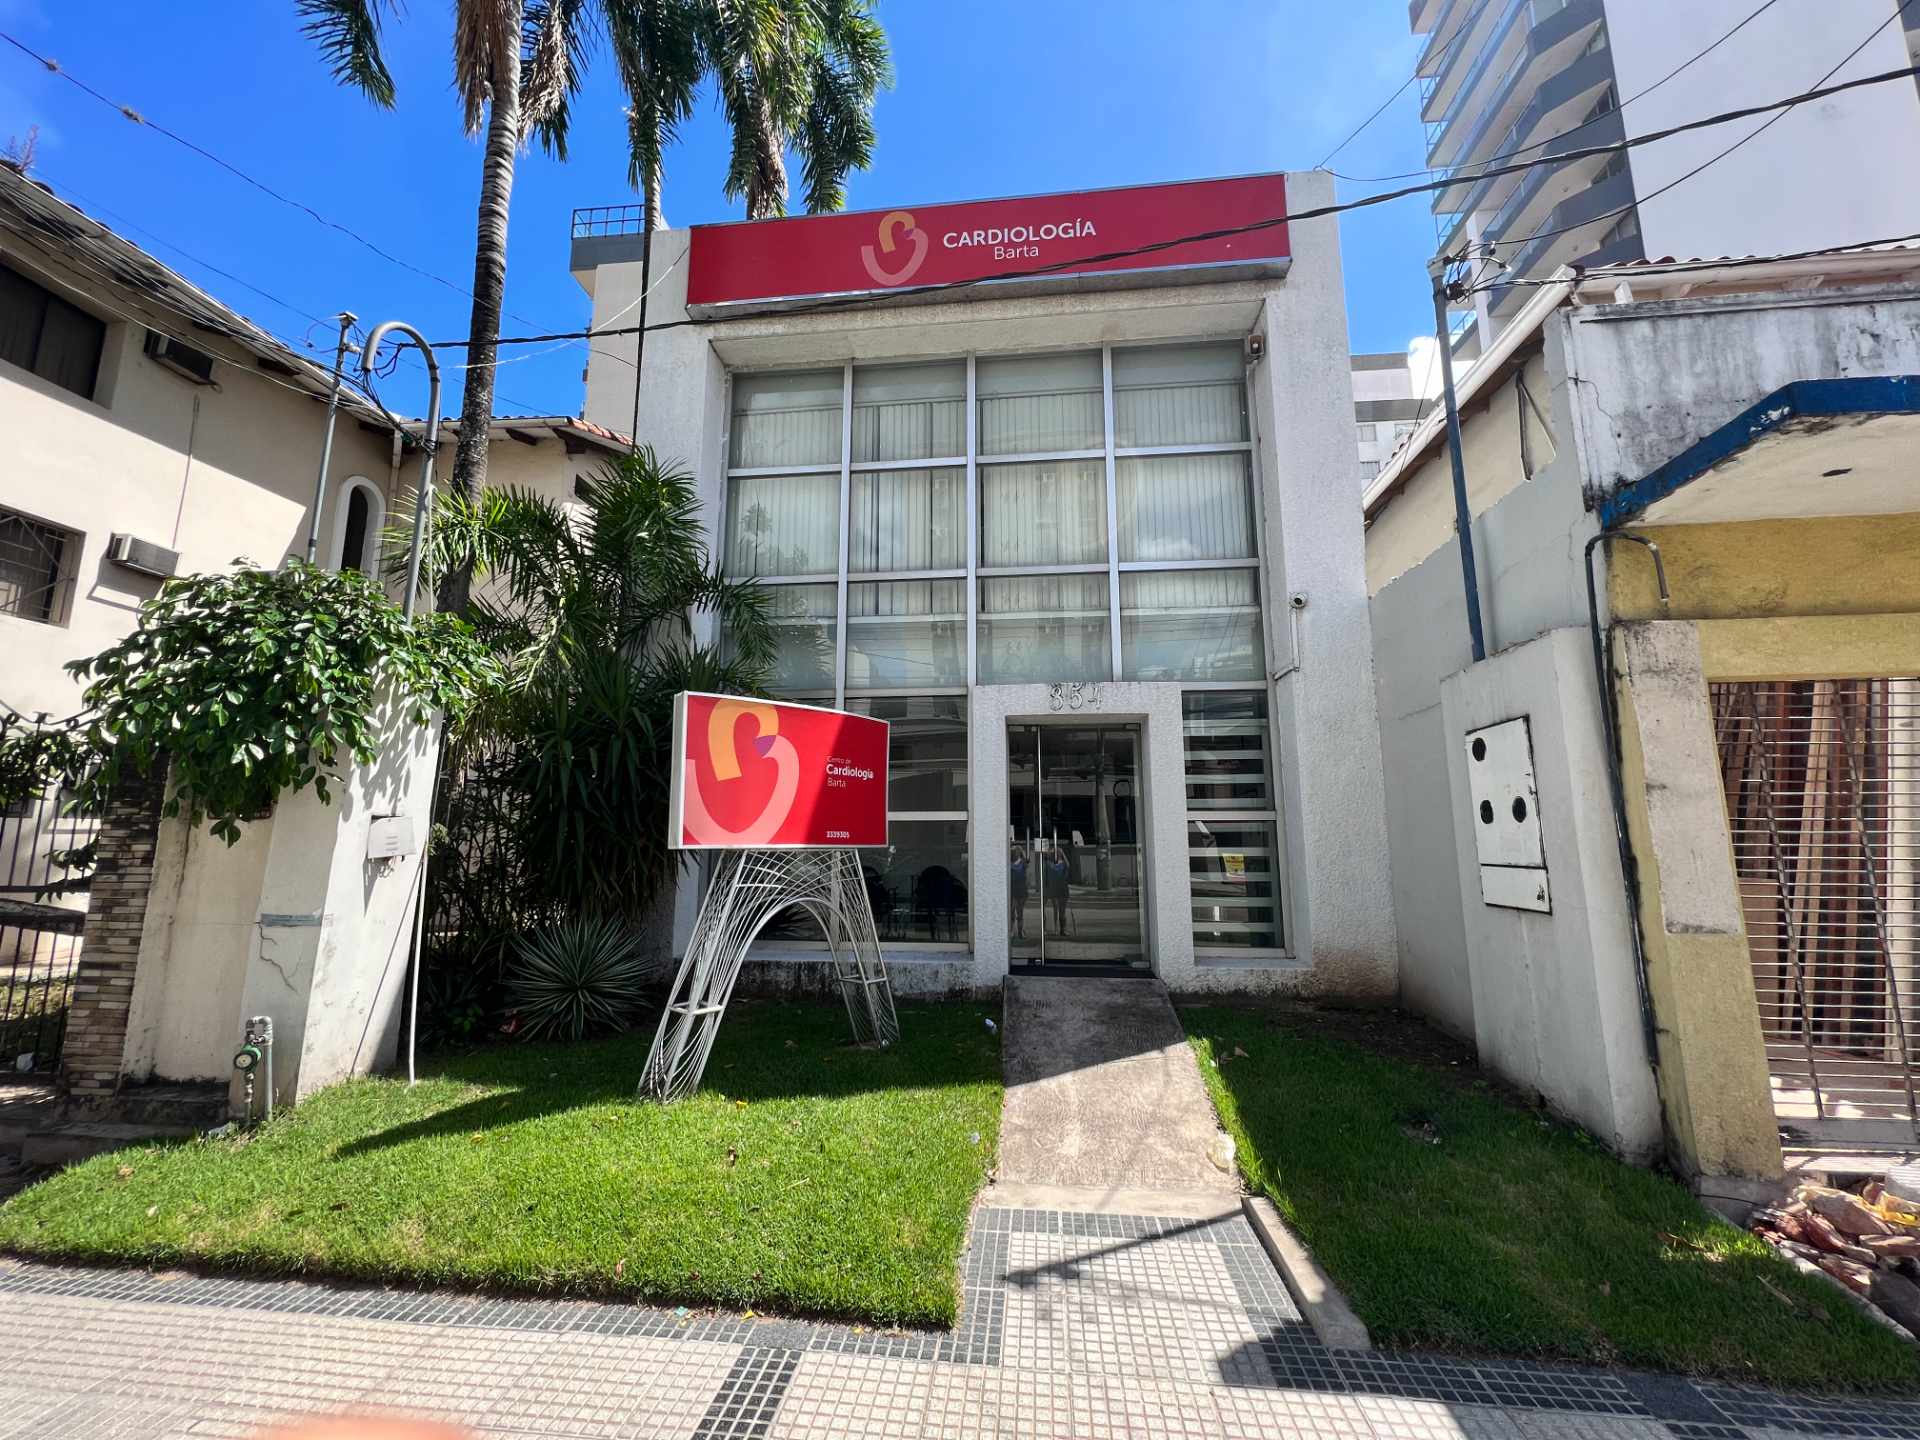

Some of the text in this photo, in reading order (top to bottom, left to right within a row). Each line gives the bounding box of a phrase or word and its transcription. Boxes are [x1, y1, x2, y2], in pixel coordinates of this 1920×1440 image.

[943, 218, 1096, 248] CARDIOLOGÍA
[994, 245, 1039, 260] Barta
[827, 777, 847, 788] Barta
